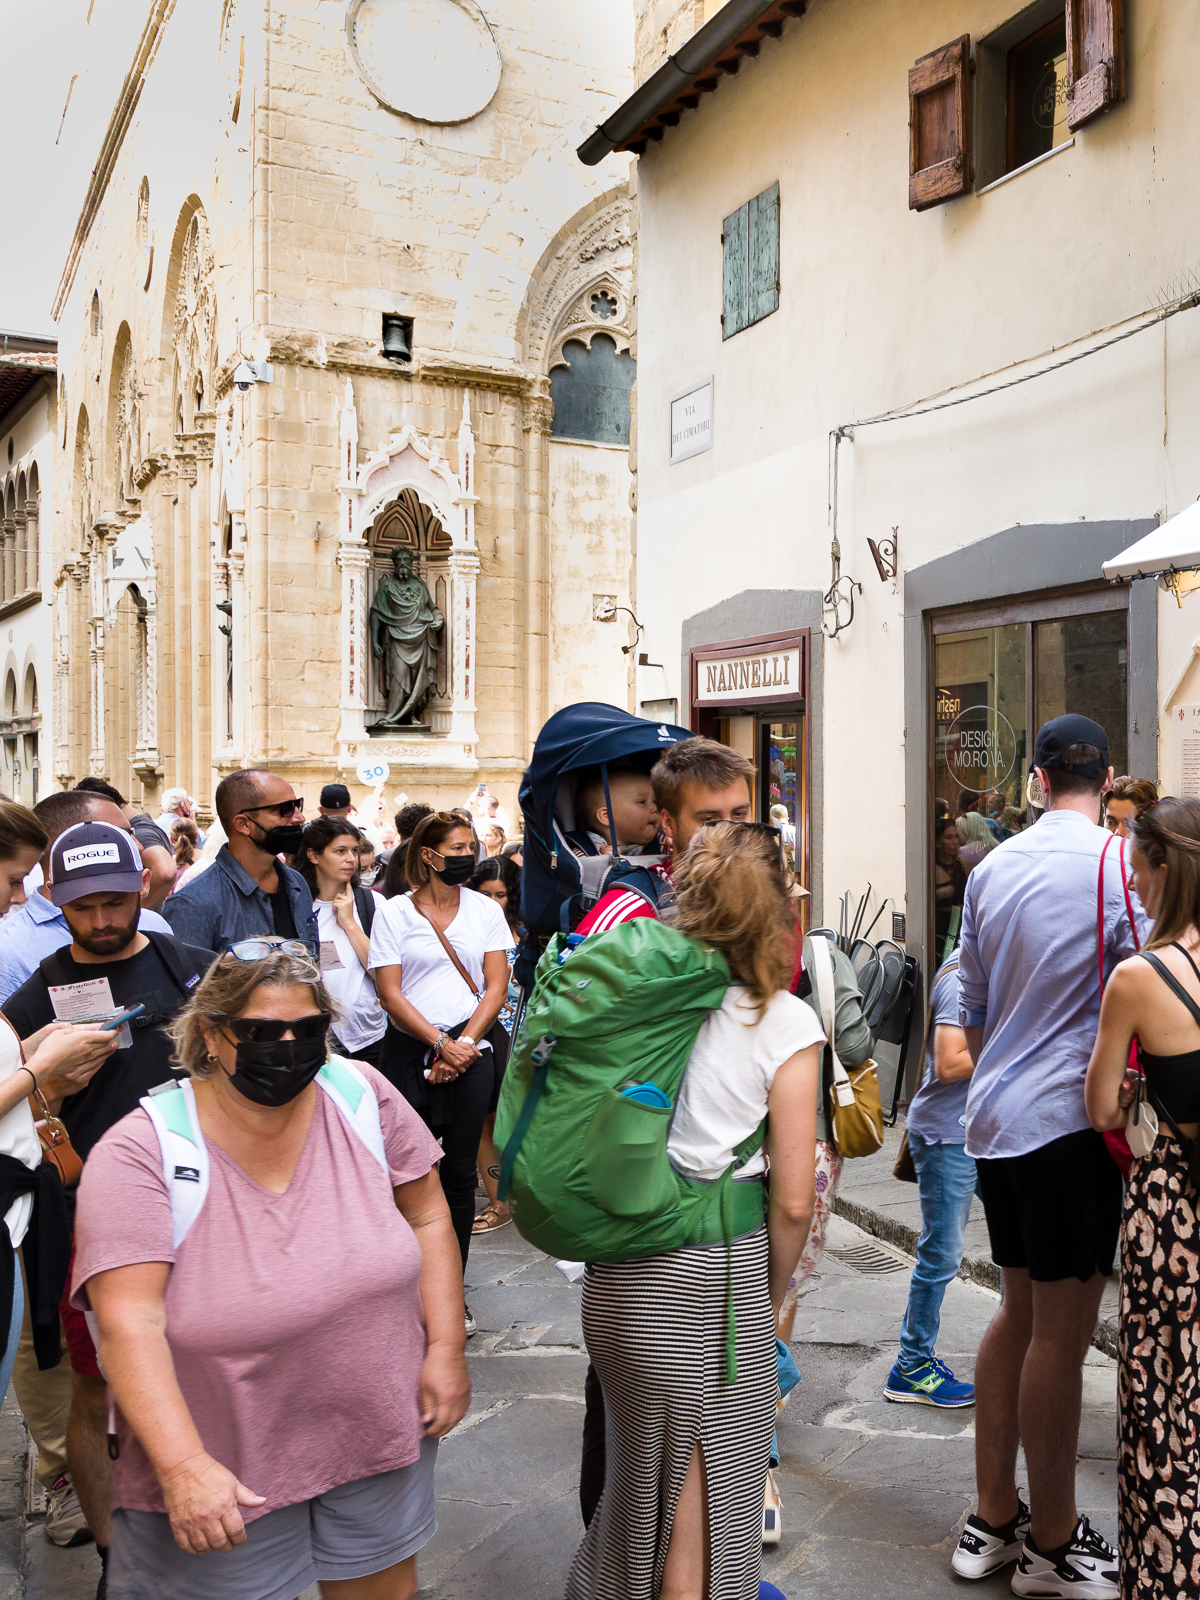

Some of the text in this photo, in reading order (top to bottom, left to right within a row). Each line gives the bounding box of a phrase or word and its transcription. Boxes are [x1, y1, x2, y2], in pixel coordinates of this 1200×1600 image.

[1044, 75, 1068, 100] DESIG
[1039, 91, 1068, 117] MO.RO
[684, 405, 696, 417] VIA
[672, 419, 710, 445] DEI CIMATORI
[706, 655, 790, 693] NANNELLI
[960, 730, 999, 748] DESIGN
[954, 750, 1006, 768] MO.RO.VA.
[363, 766, 384, 780] 30
[67, 850, 115, 863] ROGUE
